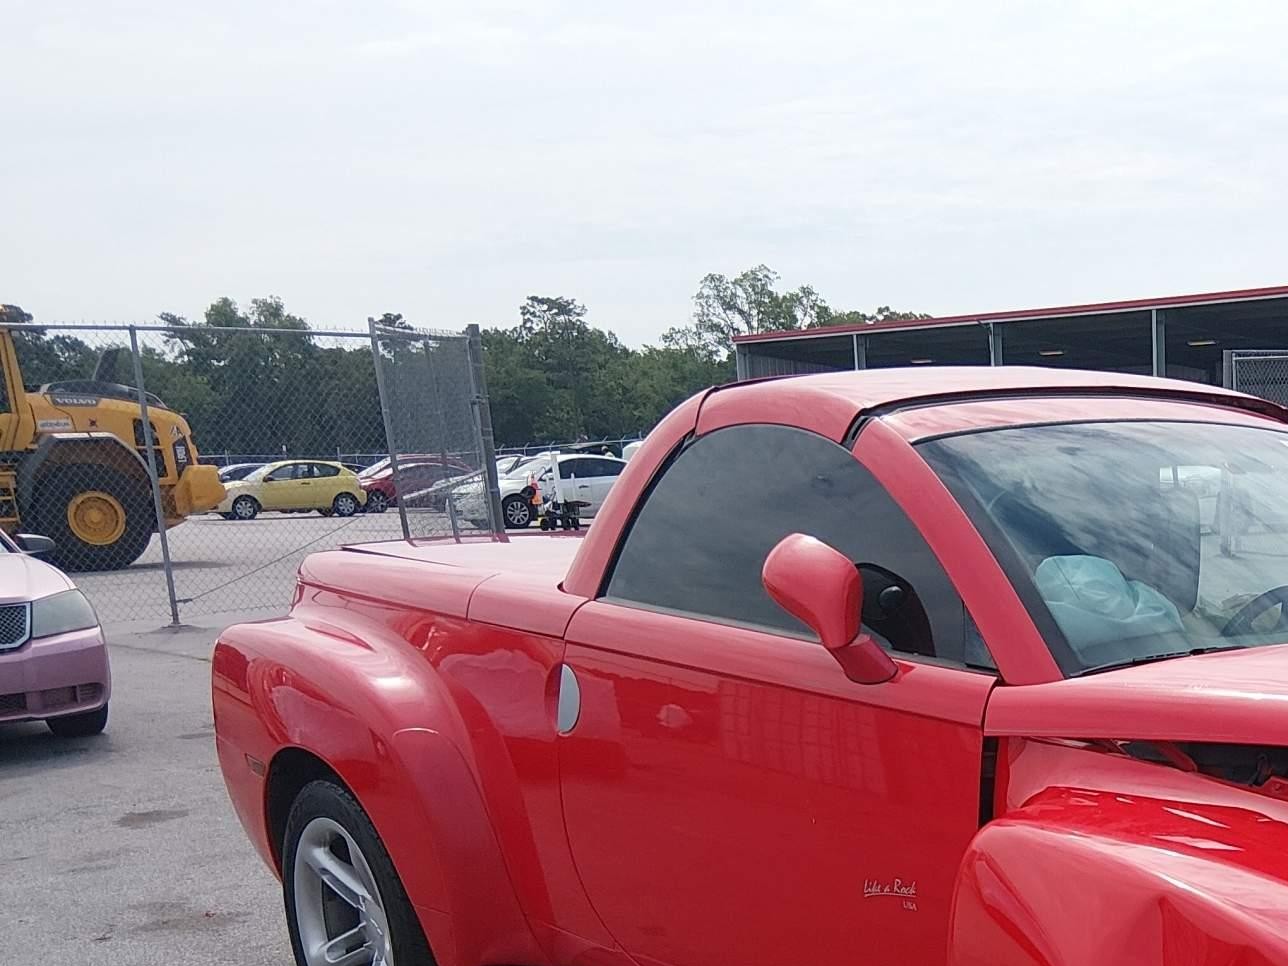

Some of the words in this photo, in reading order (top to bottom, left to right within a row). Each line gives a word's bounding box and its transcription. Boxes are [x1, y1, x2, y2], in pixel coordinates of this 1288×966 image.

[55, 397, 97, 405] VOLVO
[864, 879, 881, 893] Like
[884, 884, 891, 893] a
[894, 878, 916, 895] Rock
